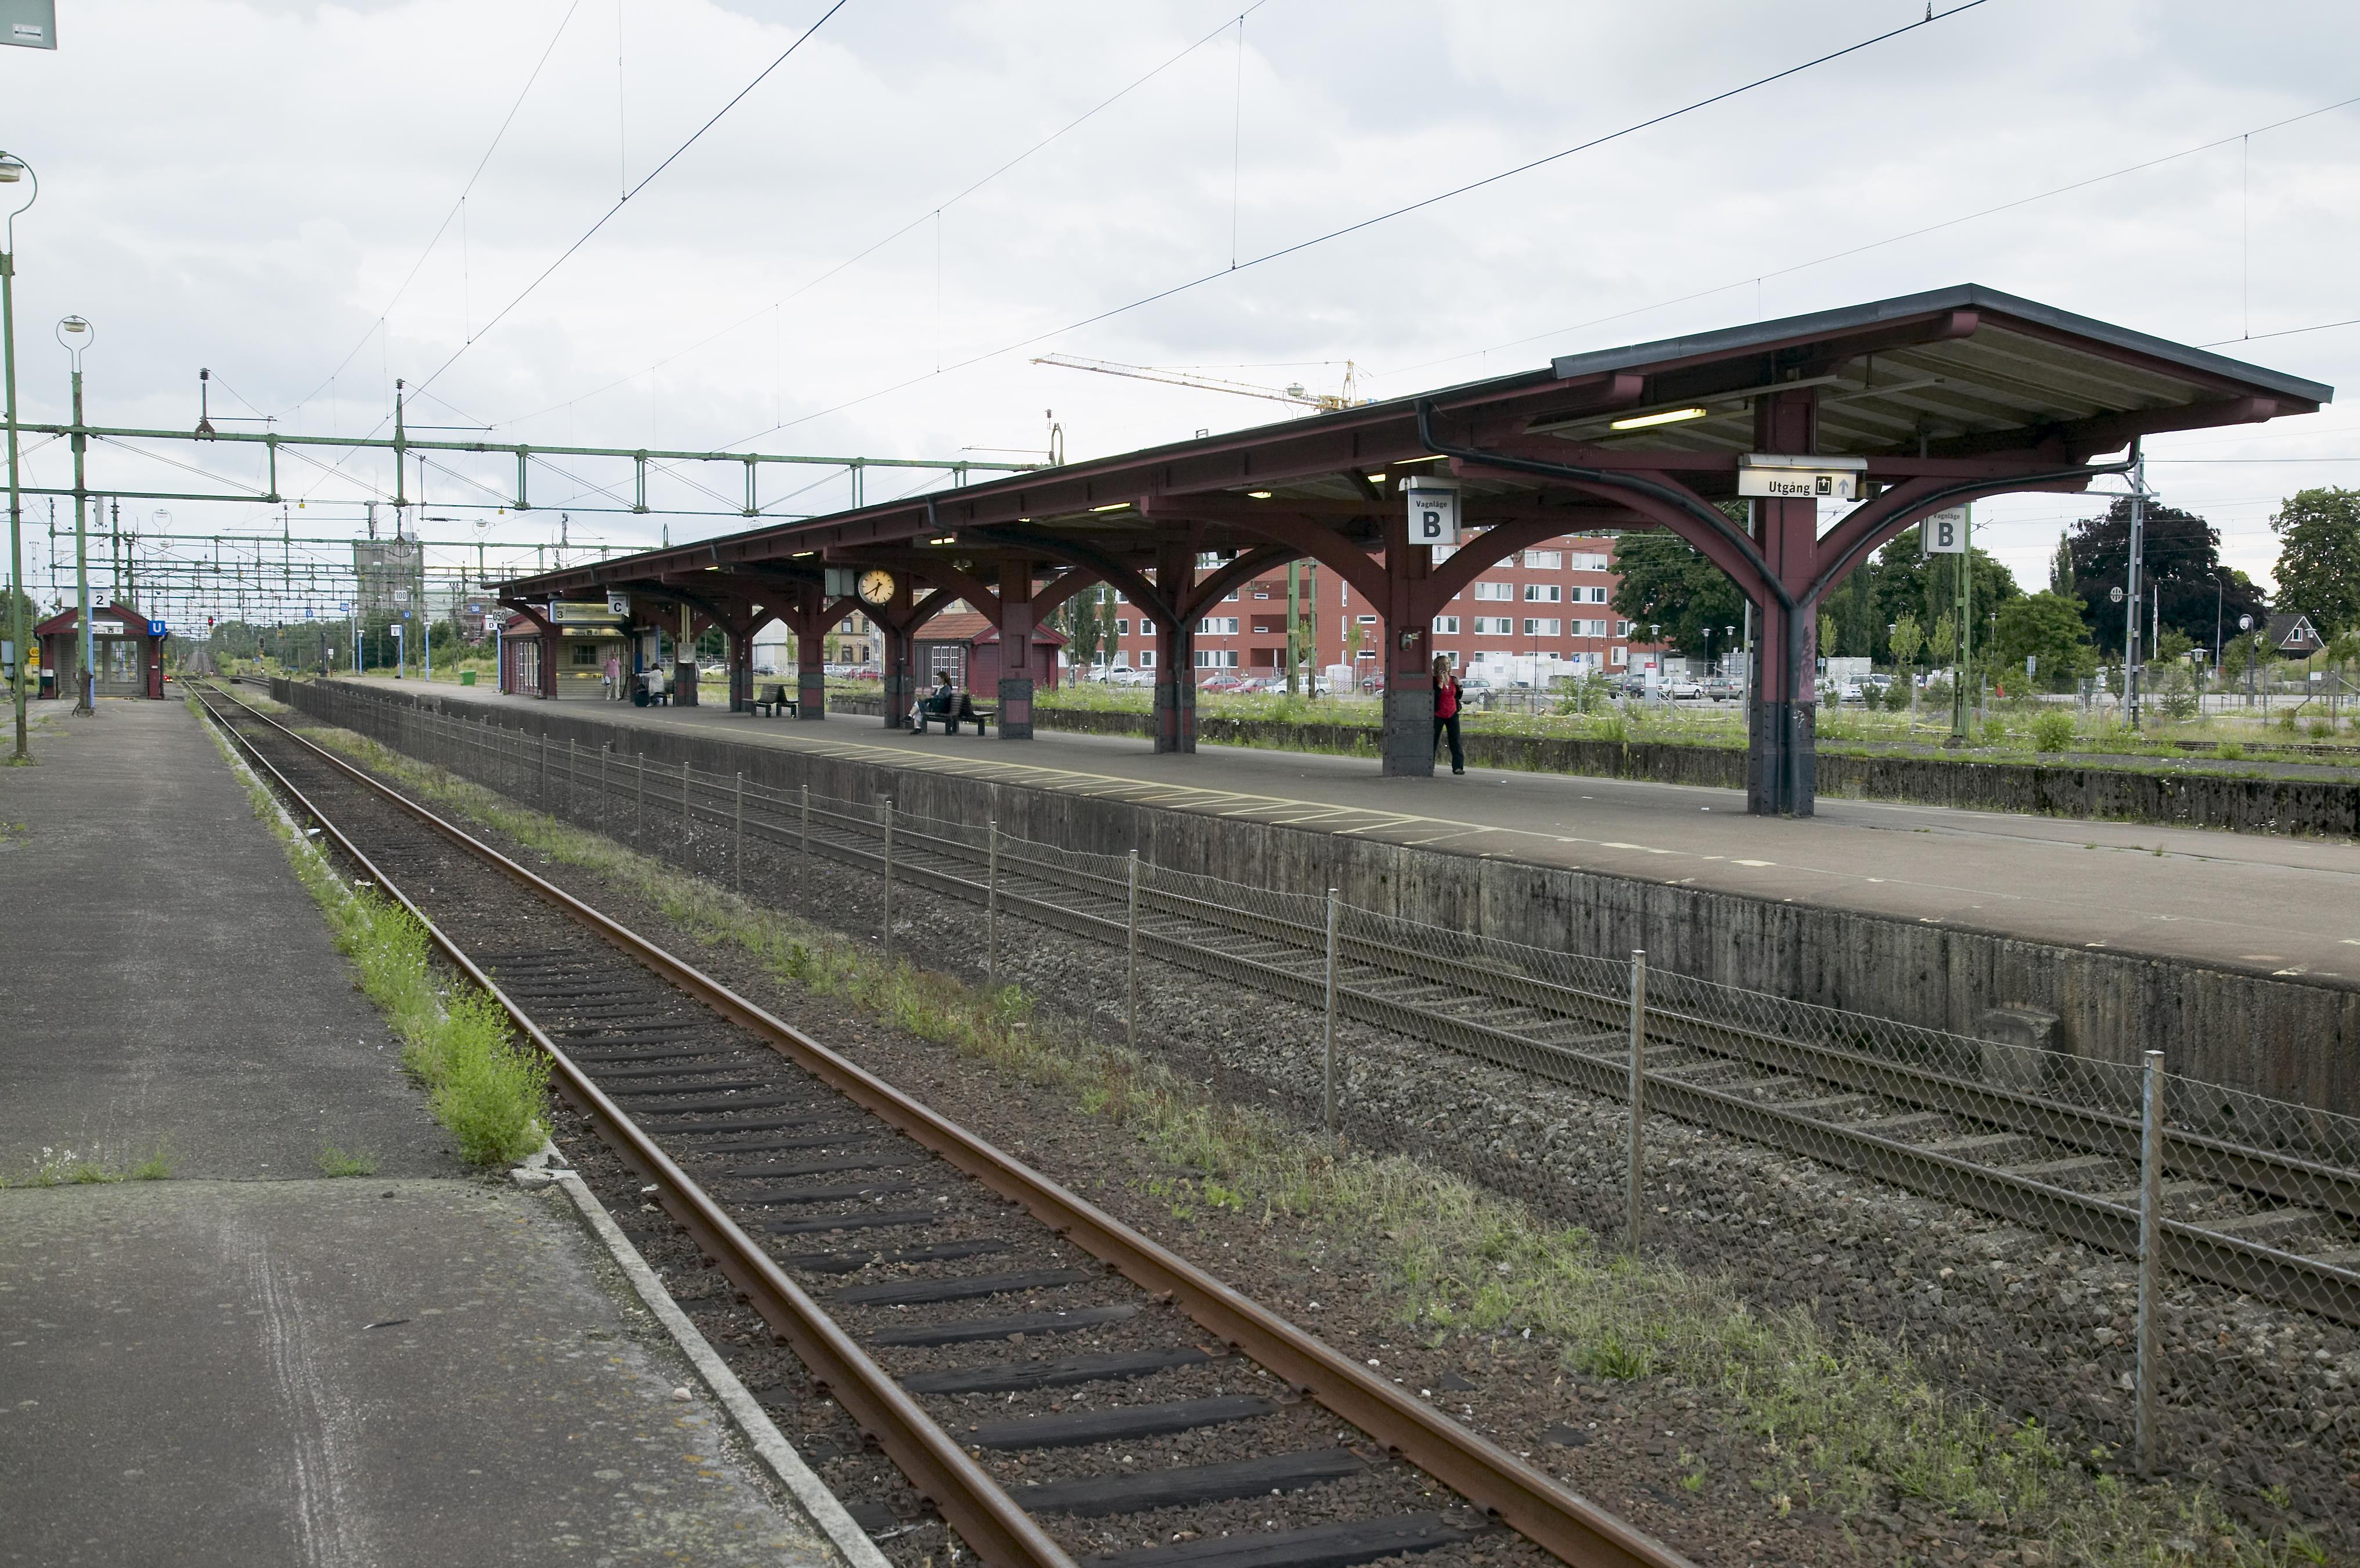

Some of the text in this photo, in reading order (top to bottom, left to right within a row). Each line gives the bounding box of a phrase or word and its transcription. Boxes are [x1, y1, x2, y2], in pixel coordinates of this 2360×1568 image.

[1769, 481, 1811, 495] Utgång
[1416, 501, 1447, 509] Vagnläge
[1423, 511, 1441, 538] B
[1938, 522, 1954, 547] B
[96, 595, 104, 605] 2
[613, 602, 622, 612] C
[492, 612, 505, 621] 050
[557, 610, 563, 618] 3
[153, 623, 162, 633] U
